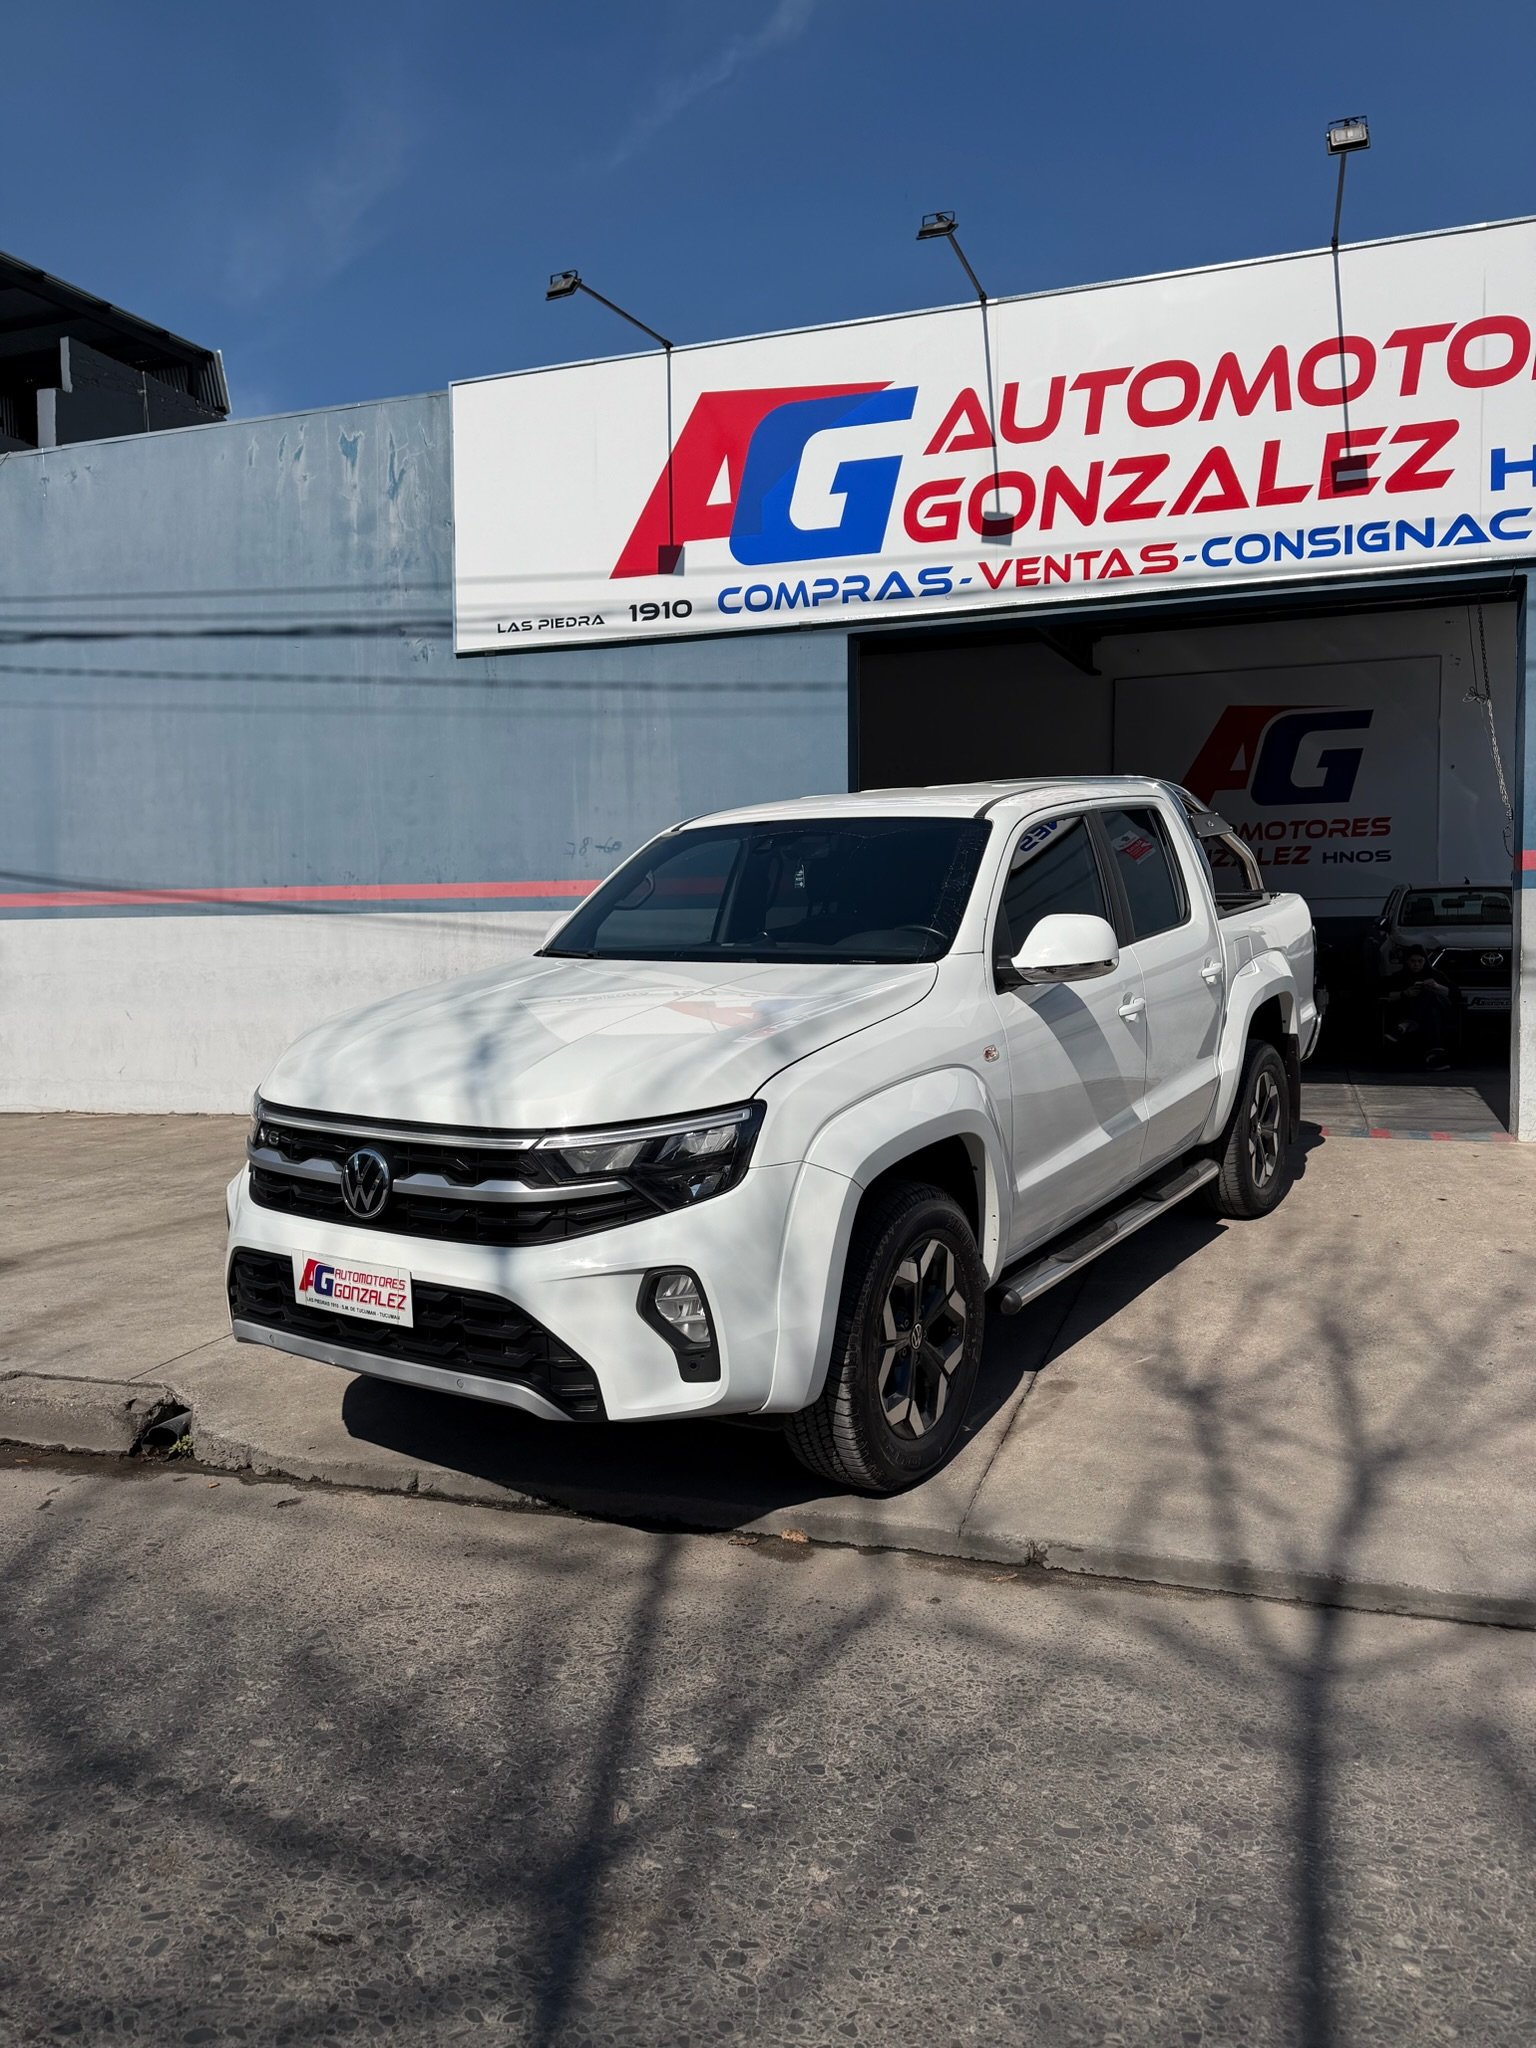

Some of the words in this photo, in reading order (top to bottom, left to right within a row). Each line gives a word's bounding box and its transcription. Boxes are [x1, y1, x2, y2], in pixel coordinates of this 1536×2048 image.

[924, 315, 1536, 455] AUTOMOTO
[610, 380, 919, 580] AG
[903, 419, 1460, 544] GONZALEZ
[497, 620, 533, 634] LAS
[538, 614, 605, 631] PIEDRA
[628, 600, 693, 622] 1910
[1204, 816, 1392, 842] MOTORES
[1322, 849, 1392, 865] HNOS
[299, 1257, 335, 1297] AG
[335, 1268, 406, 1291] AUTOMOTORES
[334, 1283, 407, 1310] GONZALEZ
